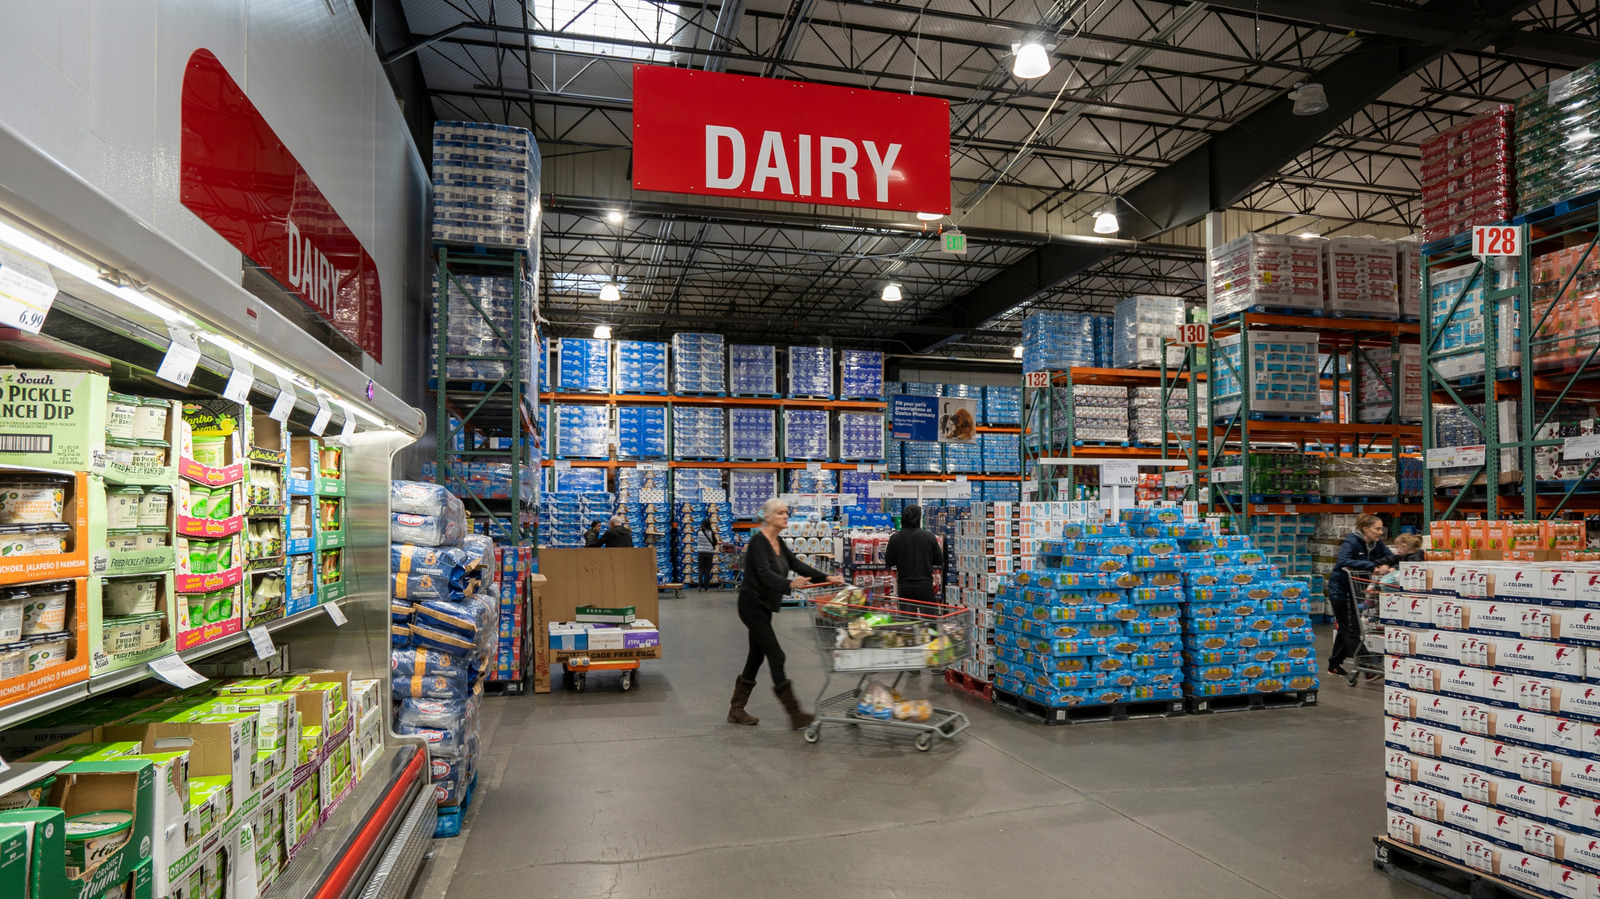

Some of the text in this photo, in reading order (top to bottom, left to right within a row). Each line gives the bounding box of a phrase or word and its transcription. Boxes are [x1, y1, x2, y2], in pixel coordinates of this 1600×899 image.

[705, 124, 902, 203] DAIRY
[946, 235, 963, 250] EXIT
[1475, 228, 1515, 254] 128
[288, 220, 340, 320] DAIRY
[19, 310, 44, 328] 6.99
[1178, 324, 1205, 342] 130
[17, 371, 54, 385] South
[1027, 373, 1048, 387] 132
[8, 385, 72, 402] PICKLE
[0, 403, 75, 420] NCH DIP
[1119, 476, 1138, 484] 10.99
[26, 560, 55, 573] JALAPEÑO
[60, 559, 86, 568] PARMESAN
[636, 649, 657, 657] EGGS
[1427, 642, 1448, 650] COLOMBE
[1509, 653, 1535, 661] COLOMBE
[26, 673, 56, 691] JALAPEÑO
[61, 664, 87, 678] PARMESAN
[1452, 678, 1475, 687] COLOMBE
[1427, 707, 1449, 716] COLOMBE
[241, 720, 250, 736] 20
[1509, 723, 1535, 733] COLOMBE
[34, 733, 49, 741] KEEP
[1453, 745, 1476, 755] COLOMBE
[1428, 771, 1450, 781] COLOMBE
[1510, 794, 1536, 805] COLOMBE
[1455, 812, 1479, 823] COLOMBE
[241, 827, 252, 845] 20
[1430, 836, 1452, 848] COLOMBE
[96, 856, 119, 879] ORGANIC
[169, 847, 199, 880] ORGANIC
[1513, 865, 1540, 878] COLOMBE
